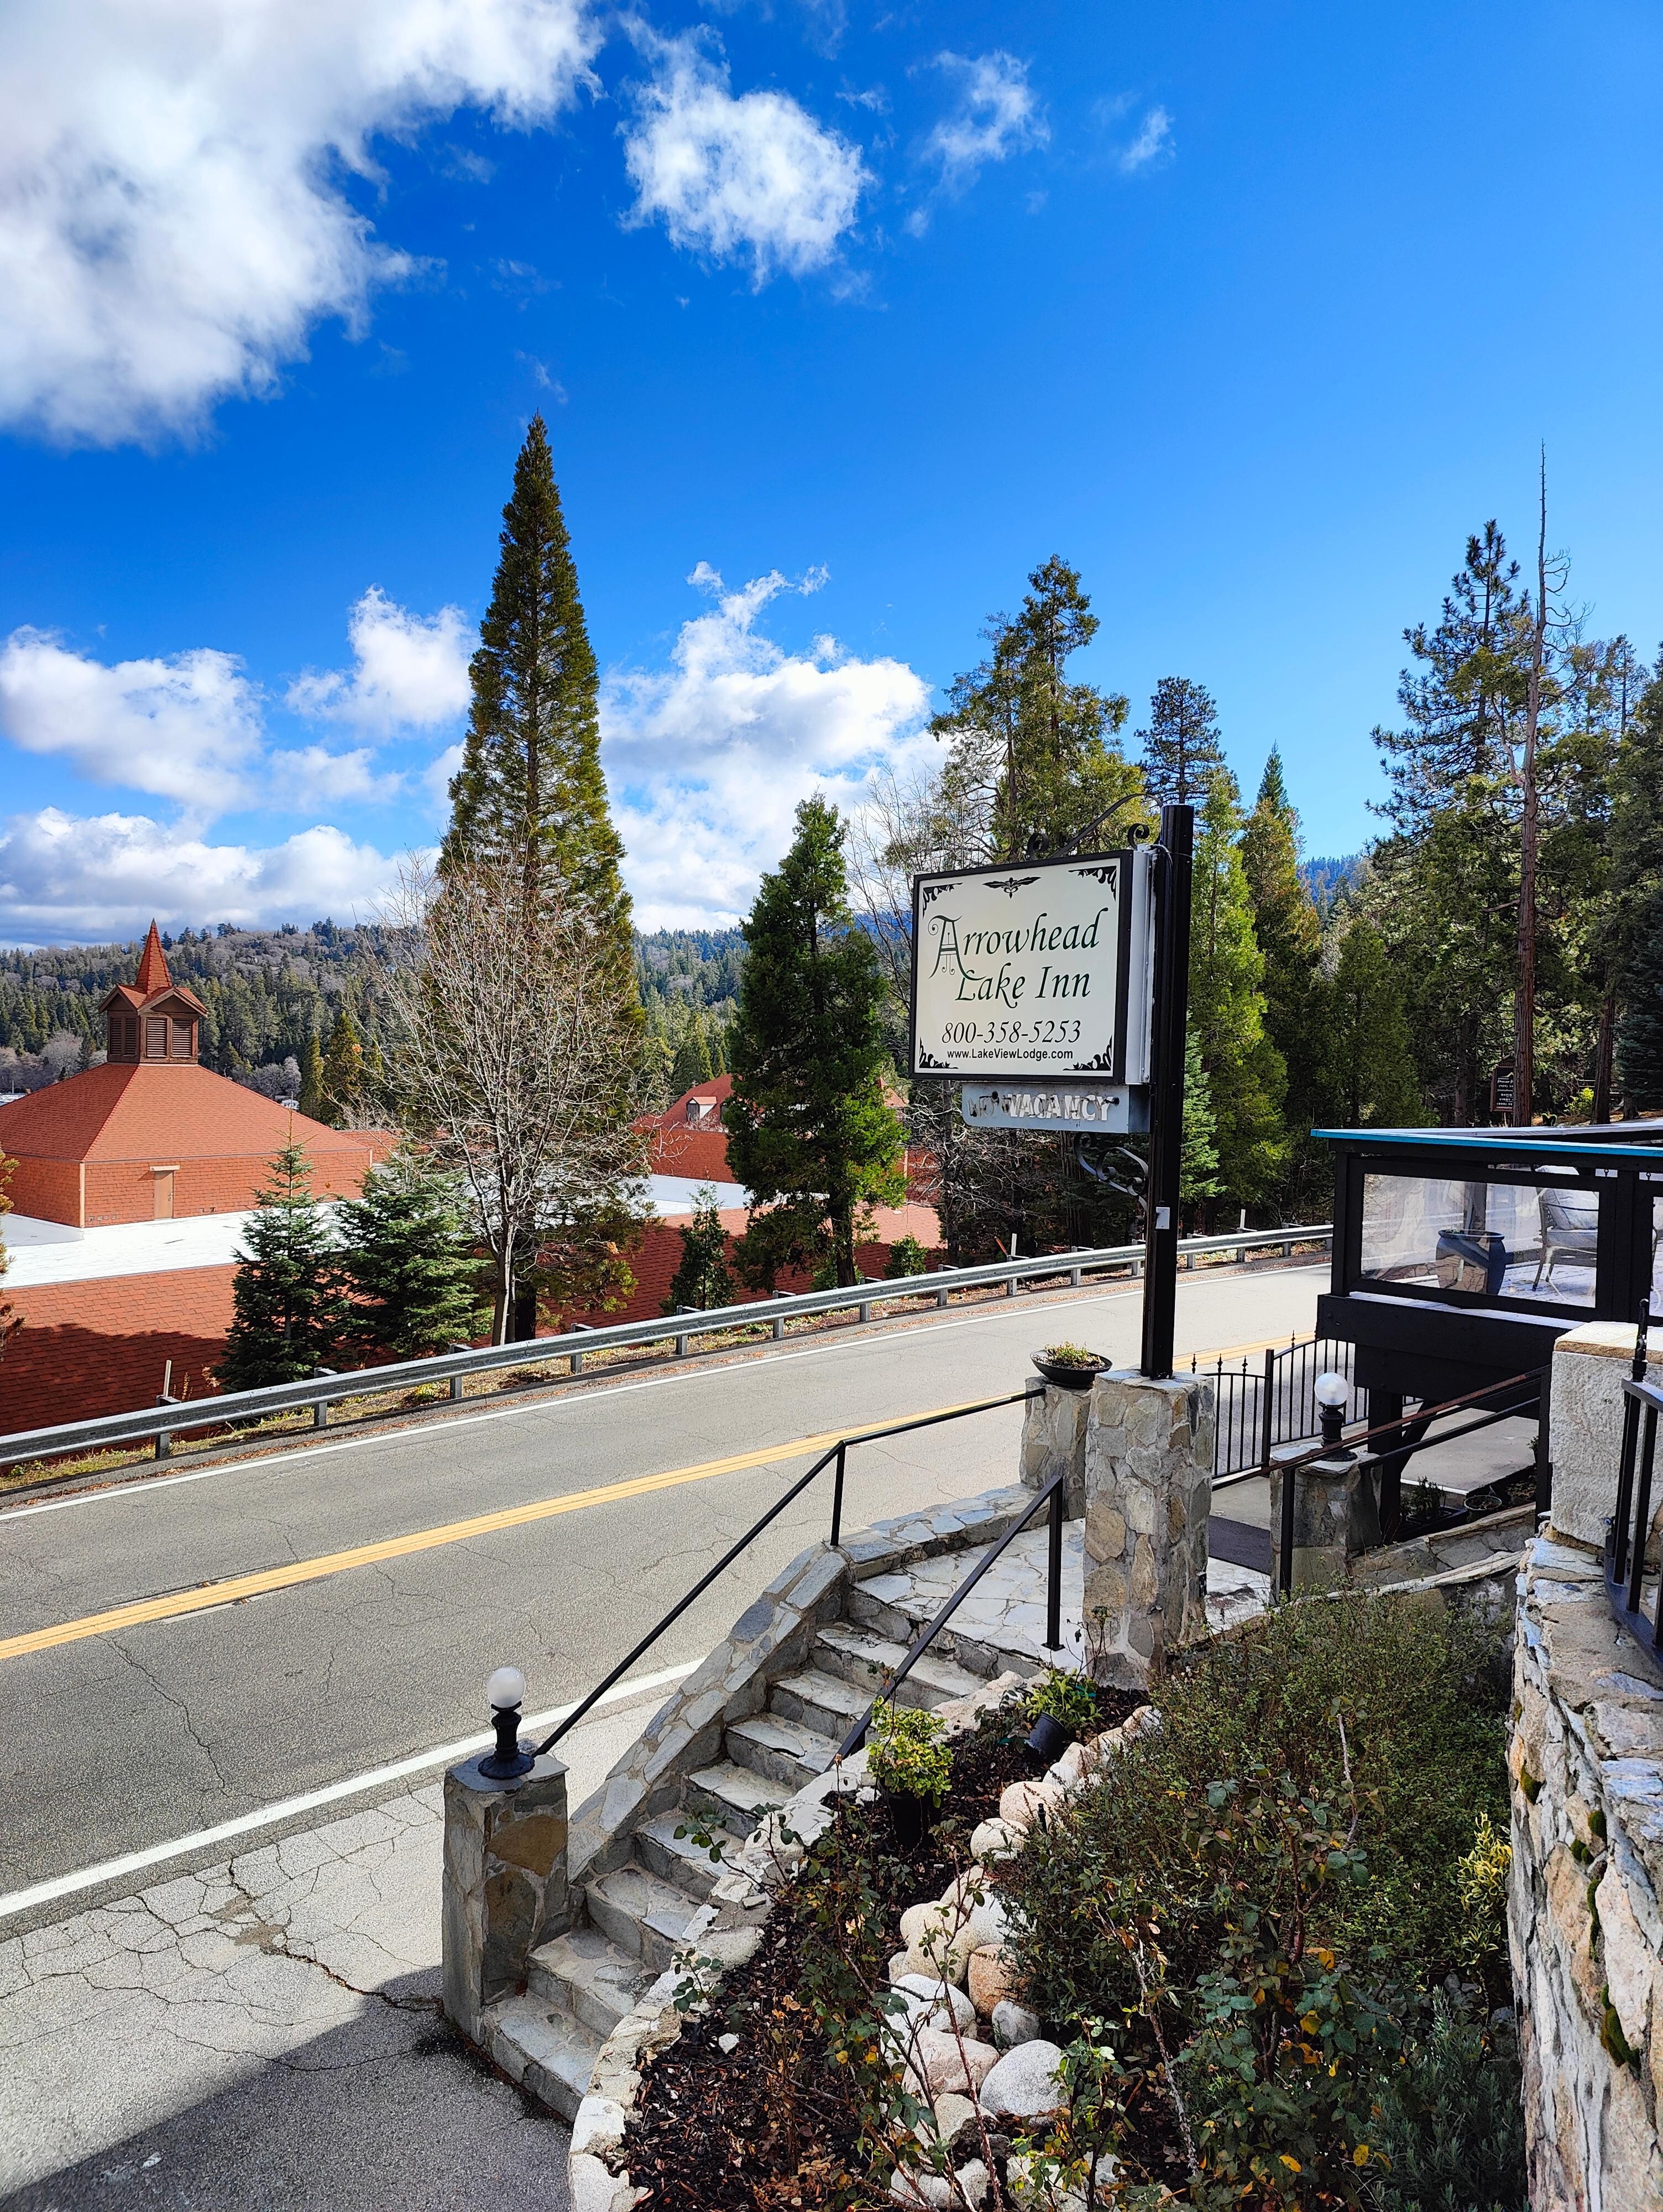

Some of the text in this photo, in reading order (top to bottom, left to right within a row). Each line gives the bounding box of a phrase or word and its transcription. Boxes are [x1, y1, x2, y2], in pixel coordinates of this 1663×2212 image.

[928, 907, 1108, 979] Arrowhead
[955, 962, 1091, 1009] Lake Inn
[942, 1020, 1081, 1044] 800-358-5253
[947, 1048, 1073, 1061] www.LakeViewLodge.com
[1007, 1093, 1113, 1121] VACANCY
